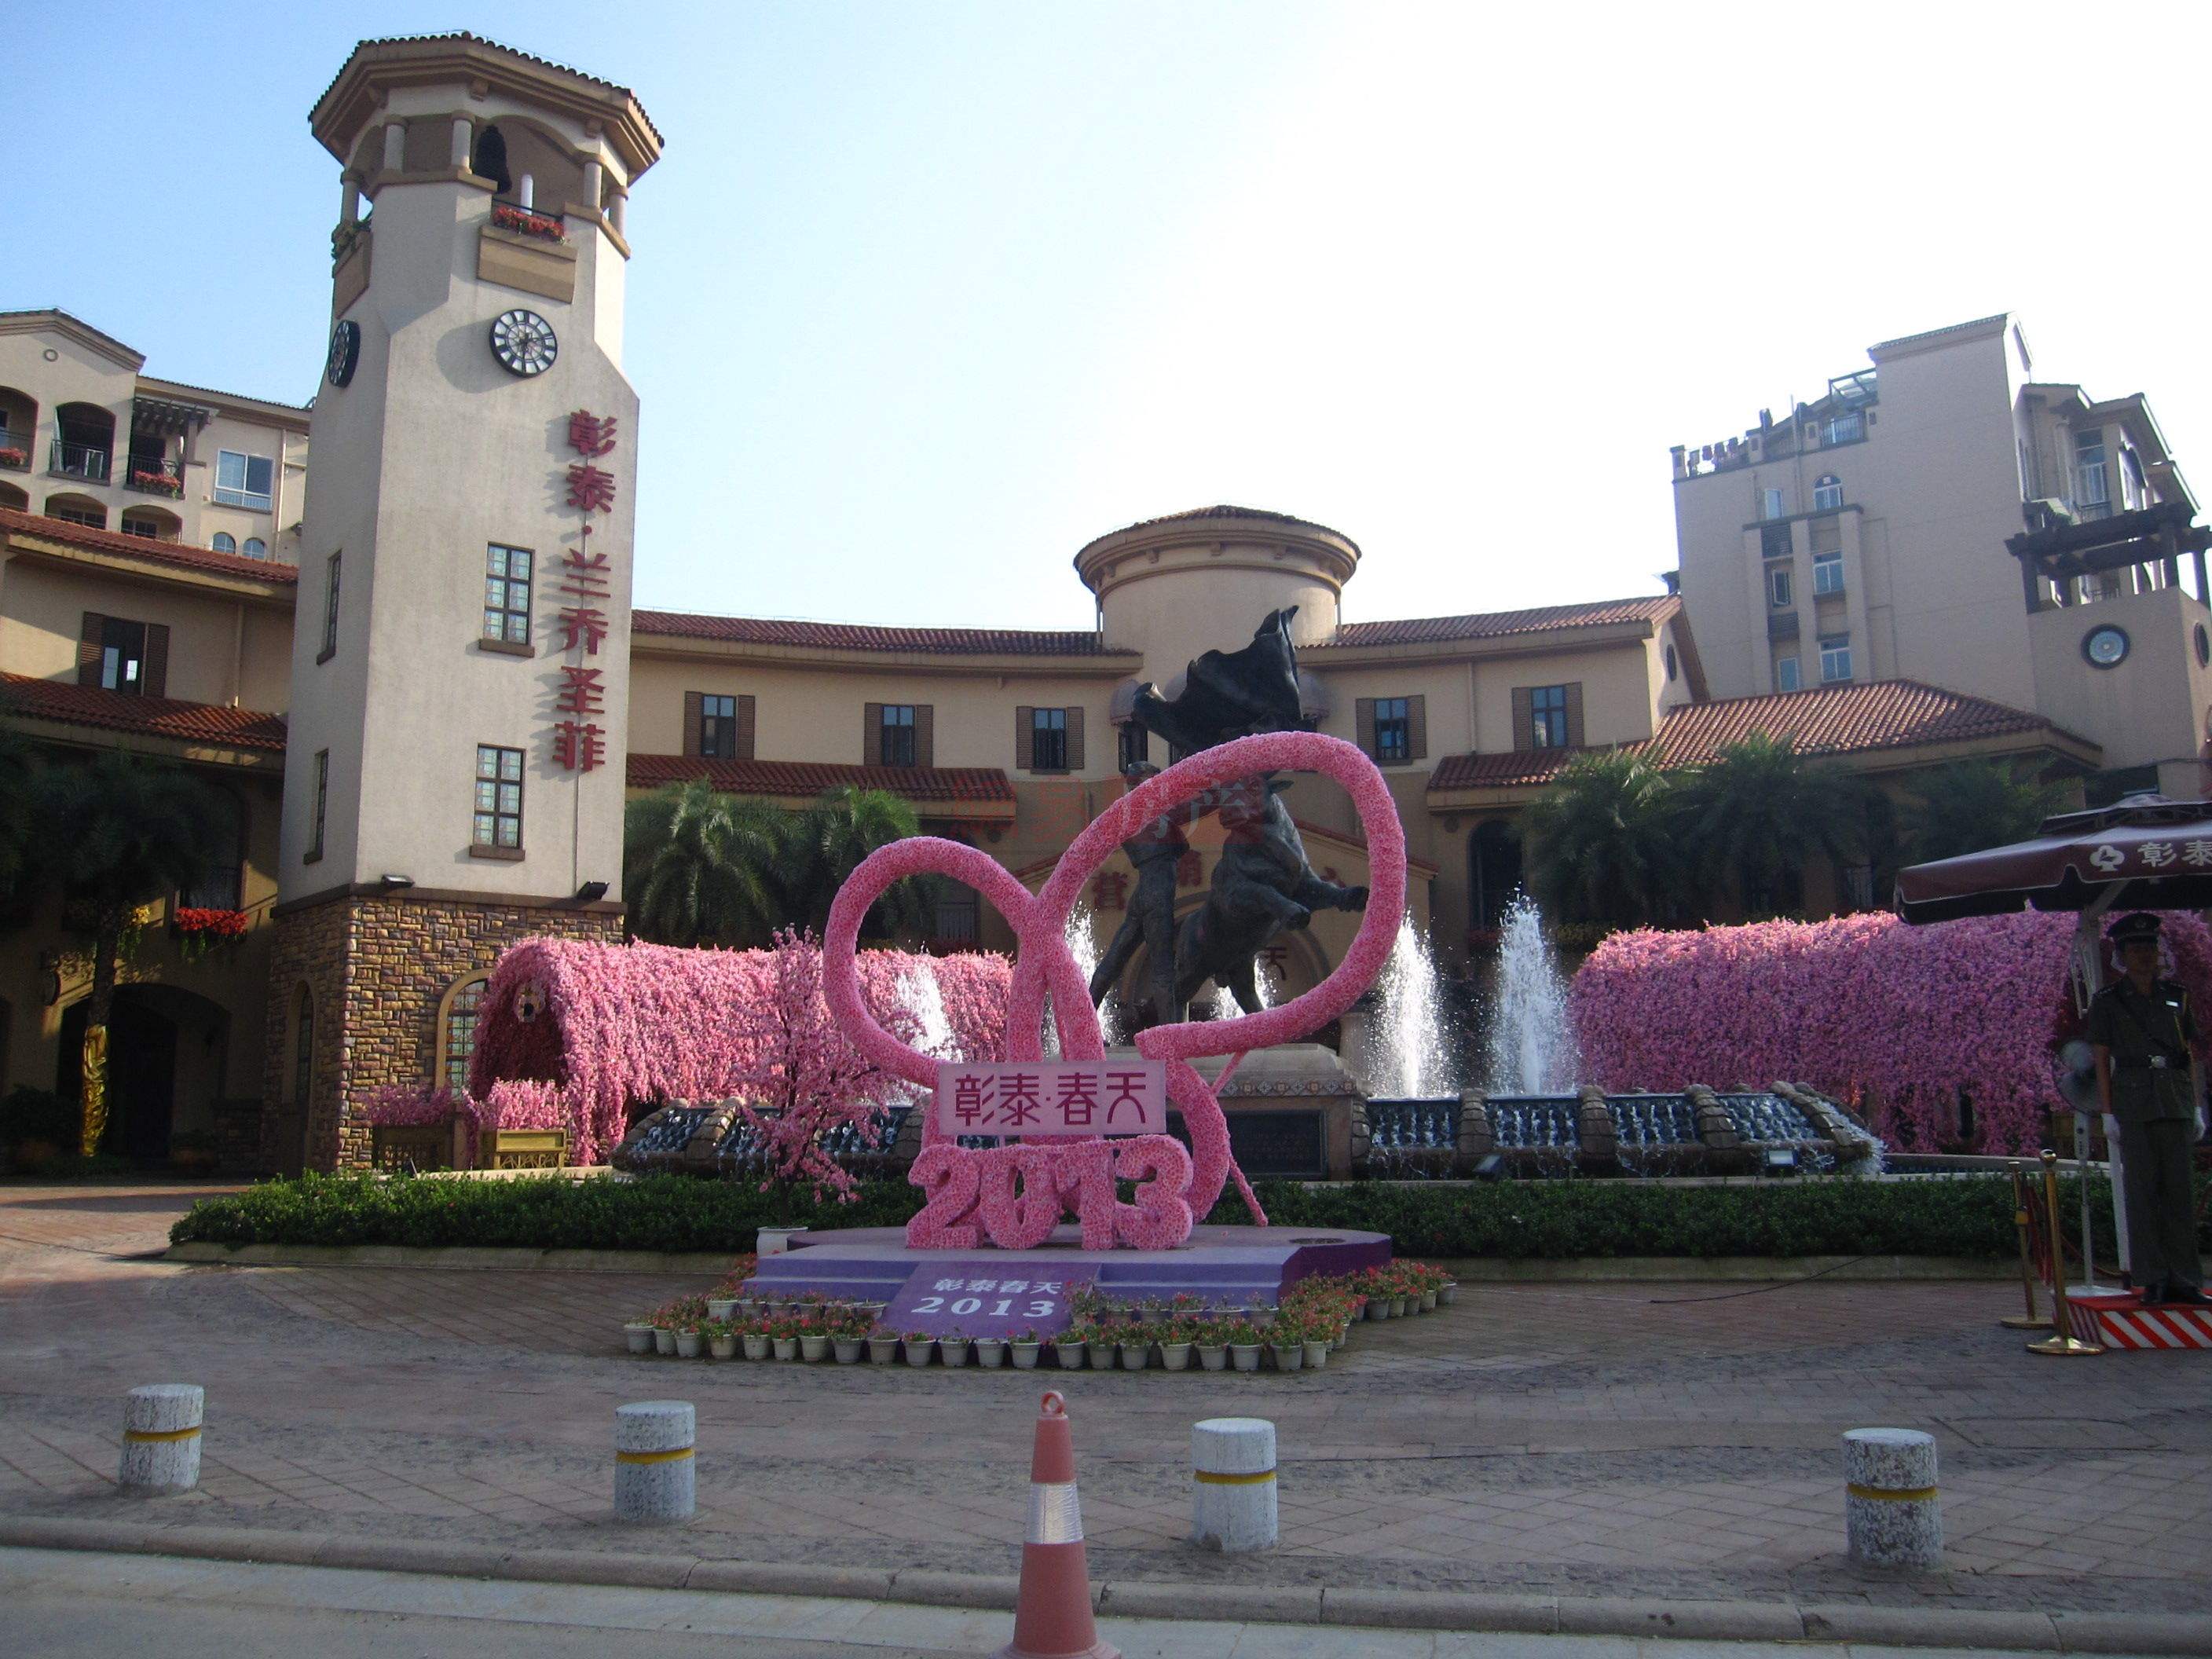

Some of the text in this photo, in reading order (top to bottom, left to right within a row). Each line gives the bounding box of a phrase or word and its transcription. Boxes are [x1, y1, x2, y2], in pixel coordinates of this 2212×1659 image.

[553, 408, 617, 771] 彰泰·兰乔圣菲
[2137, 841, 2212, 867] 彰泰
[955, 1073, 1147, 1126] 彰泰·春天
[906, 1135, 1193, 1251] 2013
[933, 1278, 1062, 1295] 彰泰春天
[911, 1297, 1055, 1317] 2013
